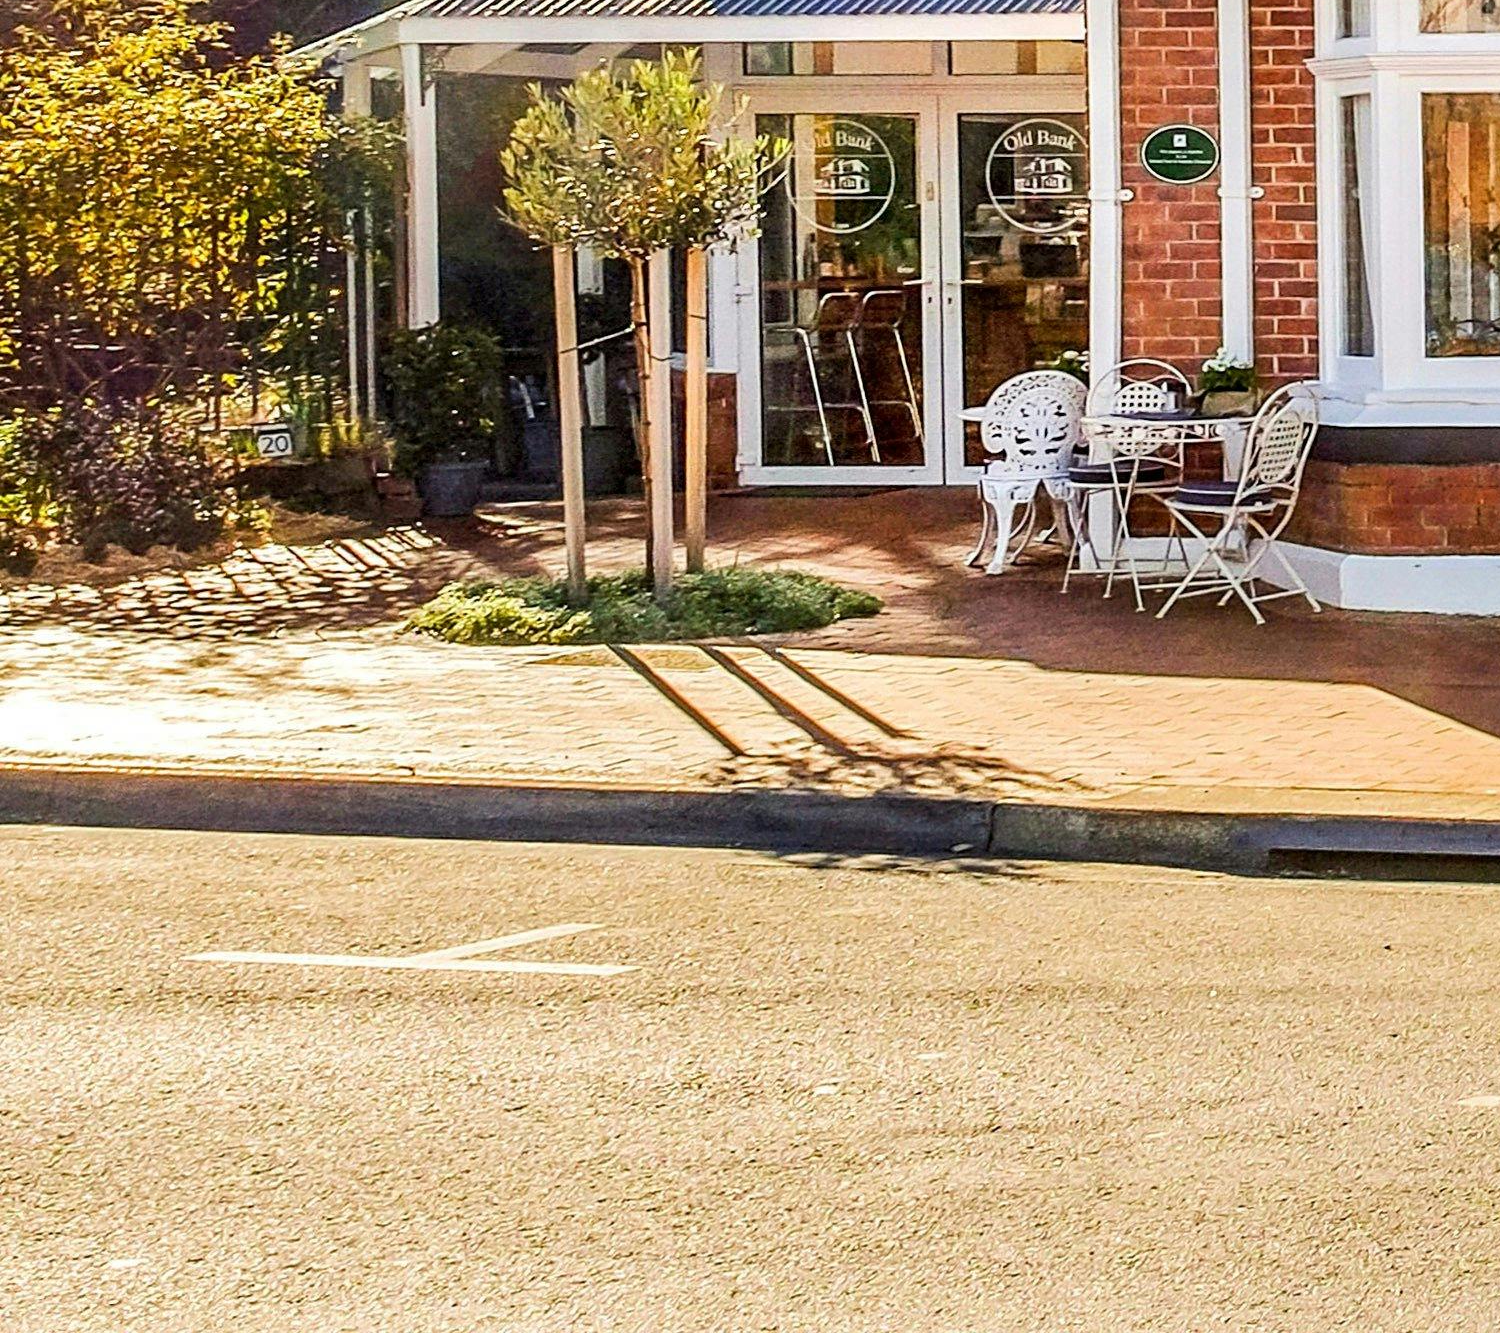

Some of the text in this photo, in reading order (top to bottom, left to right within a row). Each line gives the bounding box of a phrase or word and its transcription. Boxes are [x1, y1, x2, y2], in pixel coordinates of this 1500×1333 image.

[835, 130, 875, 152] Bank
[1003, 129, 1077, 152] Old Bank
[260, 435, 289, 454] 20
